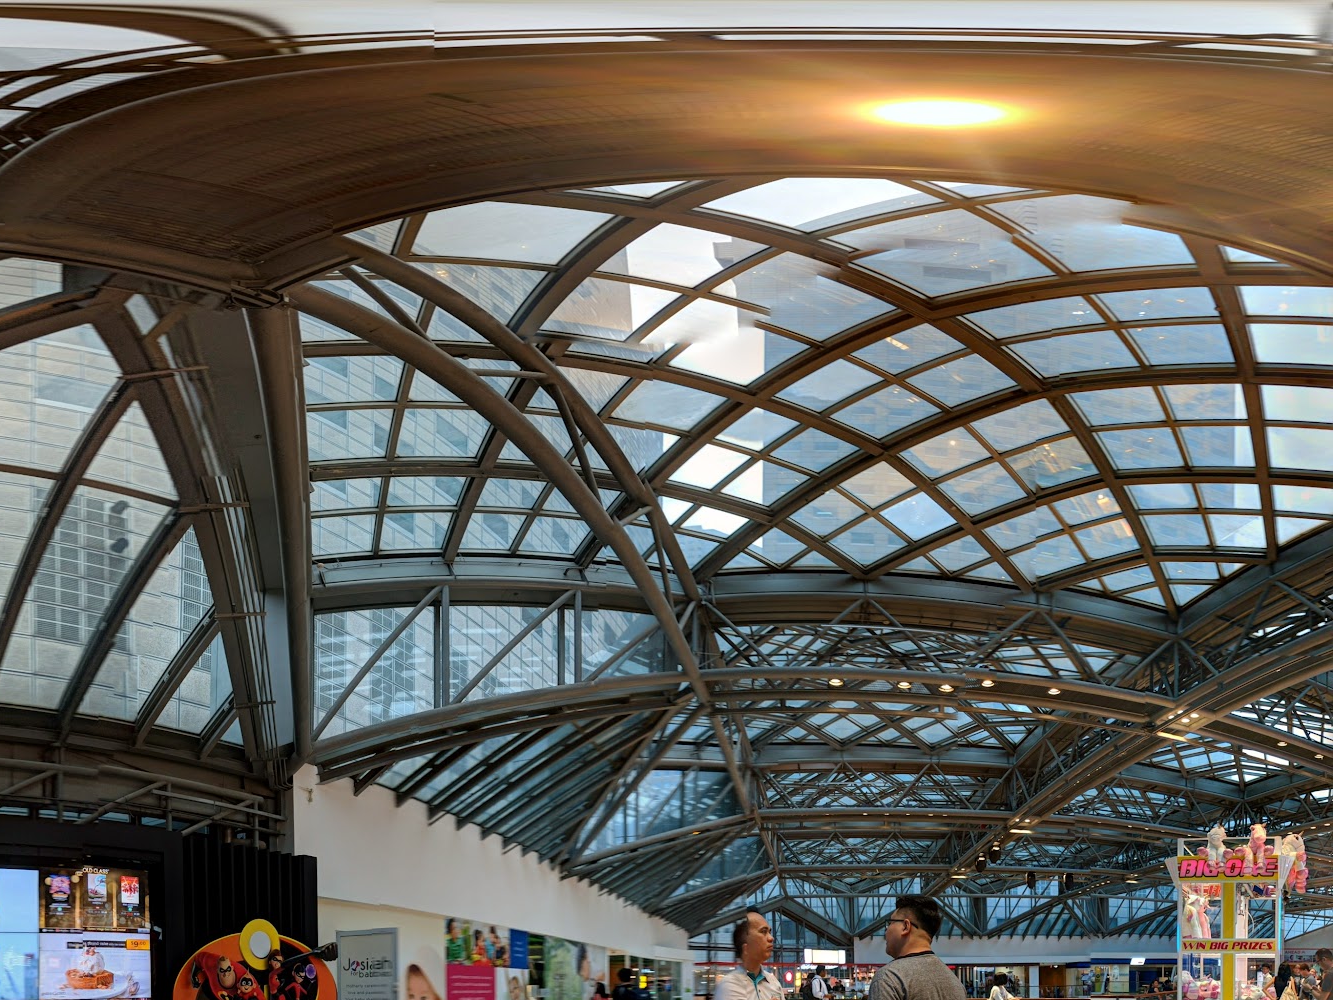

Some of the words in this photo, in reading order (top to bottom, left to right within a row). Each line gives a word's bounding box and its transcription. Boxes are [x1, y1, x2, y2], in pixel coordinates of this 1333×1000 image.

[1183, 941, 1207, 950] WIN
[1209, 941, 1229, 950] BIG
[1232, 941, 1274, 950] PRIZES
